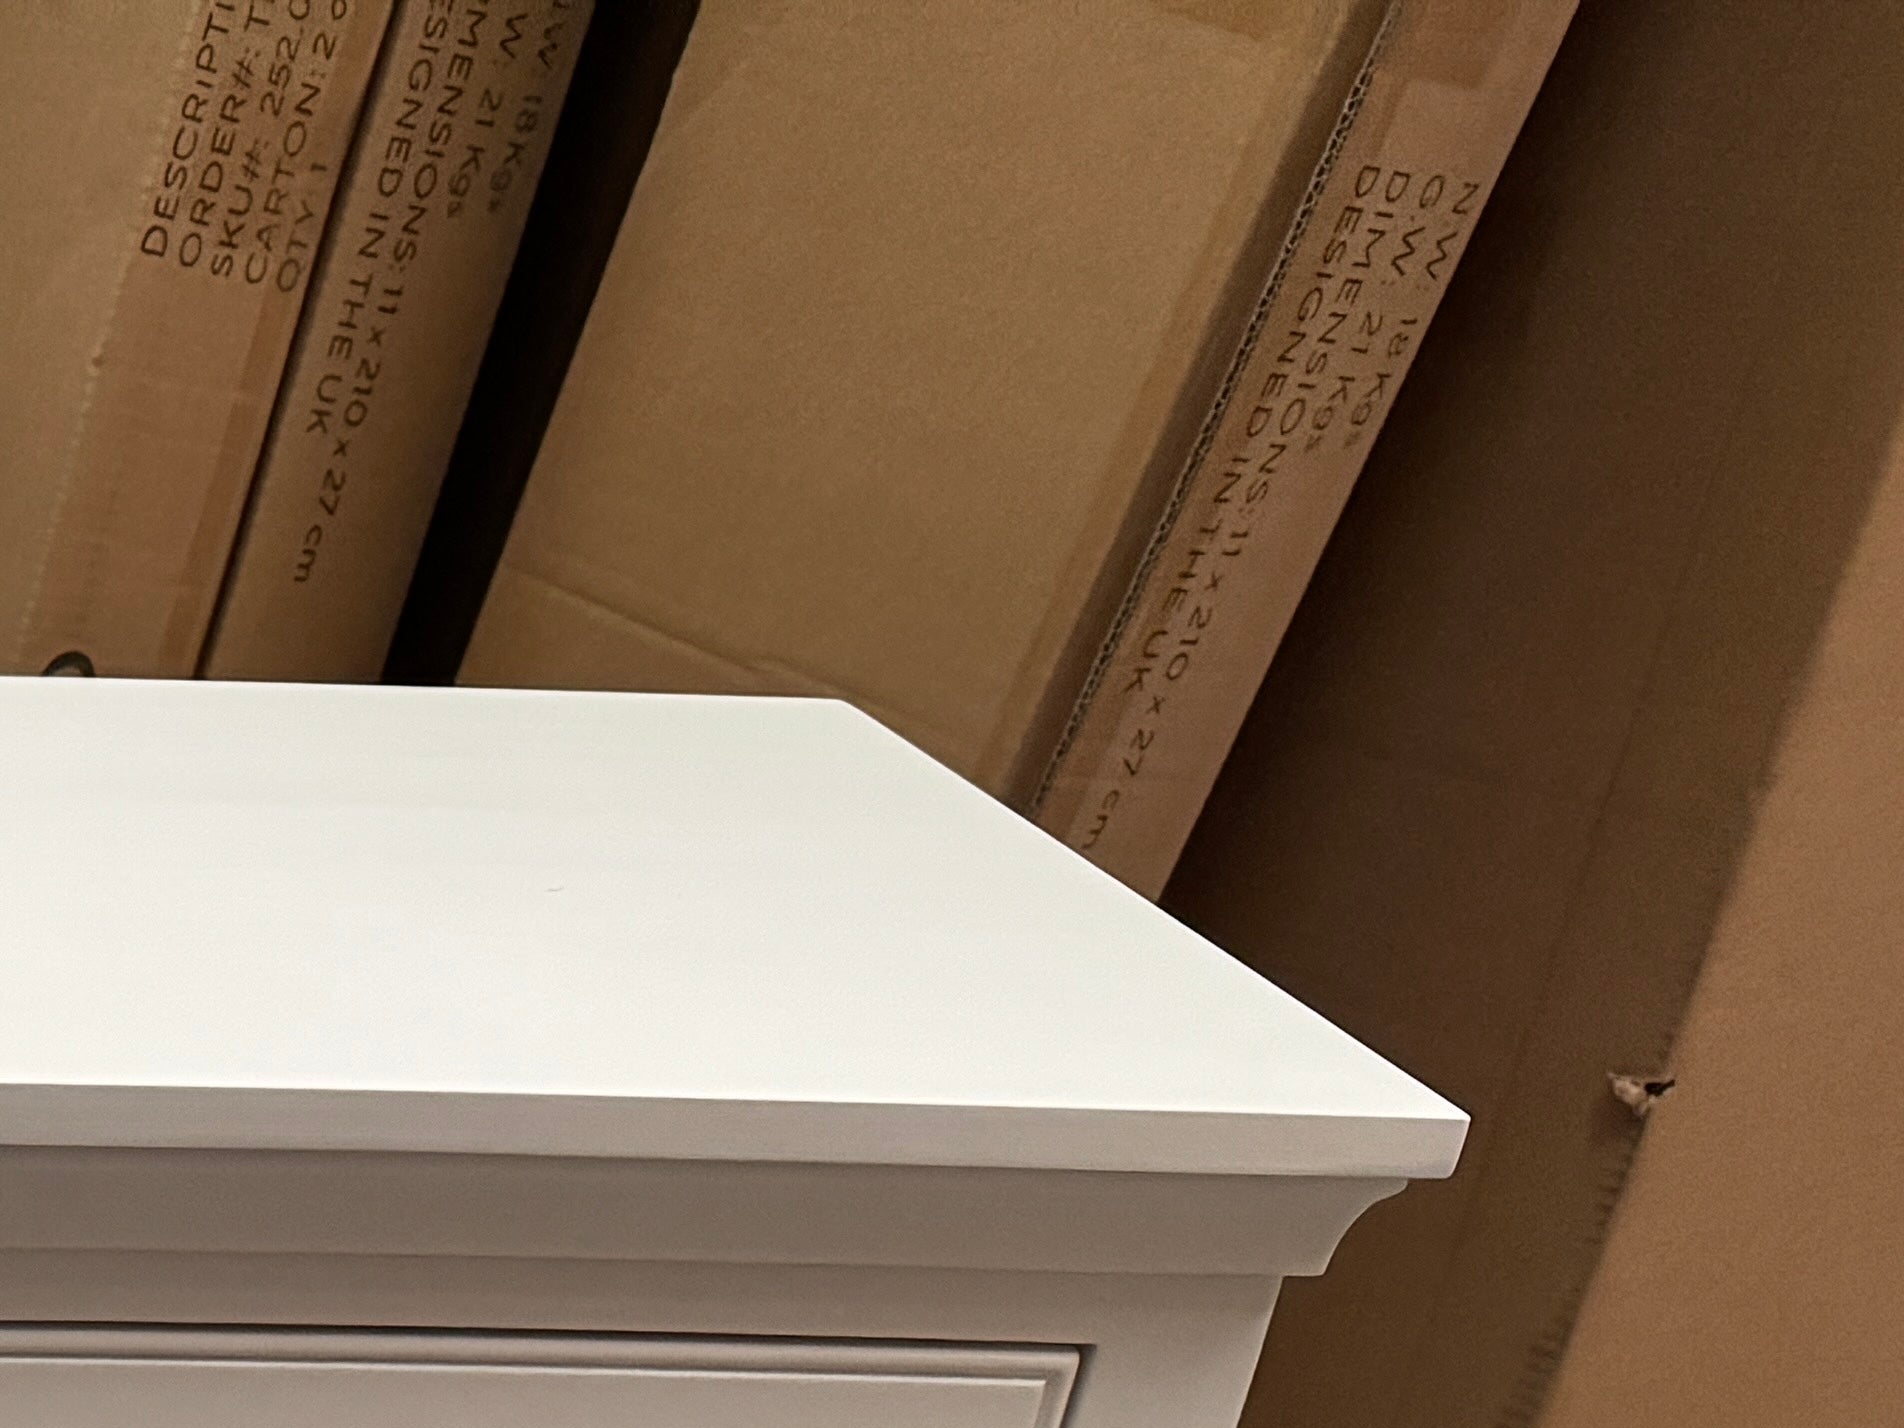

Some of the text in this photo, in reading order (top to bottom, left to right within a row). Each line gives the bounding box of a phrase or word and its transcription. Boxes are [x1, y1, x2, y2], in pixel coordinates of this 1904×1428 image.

[476, 89, 503, 127] 21
[245, 70, 326, 284] CARTON:
[312, 32, 339, 60] 2
[358, 213, 389, 258] IN
[294, 0, 489, 583] MENSIONS: 11 x 210 x 27 cm
[327, 272, 373, 360] THE
[1238, 171, 1410, 517] DIMENSIONS:
[1351, 312, 1383, 354] 21
[306, 373, 343, 434] UK
[1124, 165, 1380, 694] DESIGNED IN THE UK
[1222, 531, 1249, 556] 11
[1206, 571, 1223, 592] x
[1166, 606, 1213, 681] 210
[1123, 728, 1155, 776] 27
[1081, 789, 1120, 849] cm
